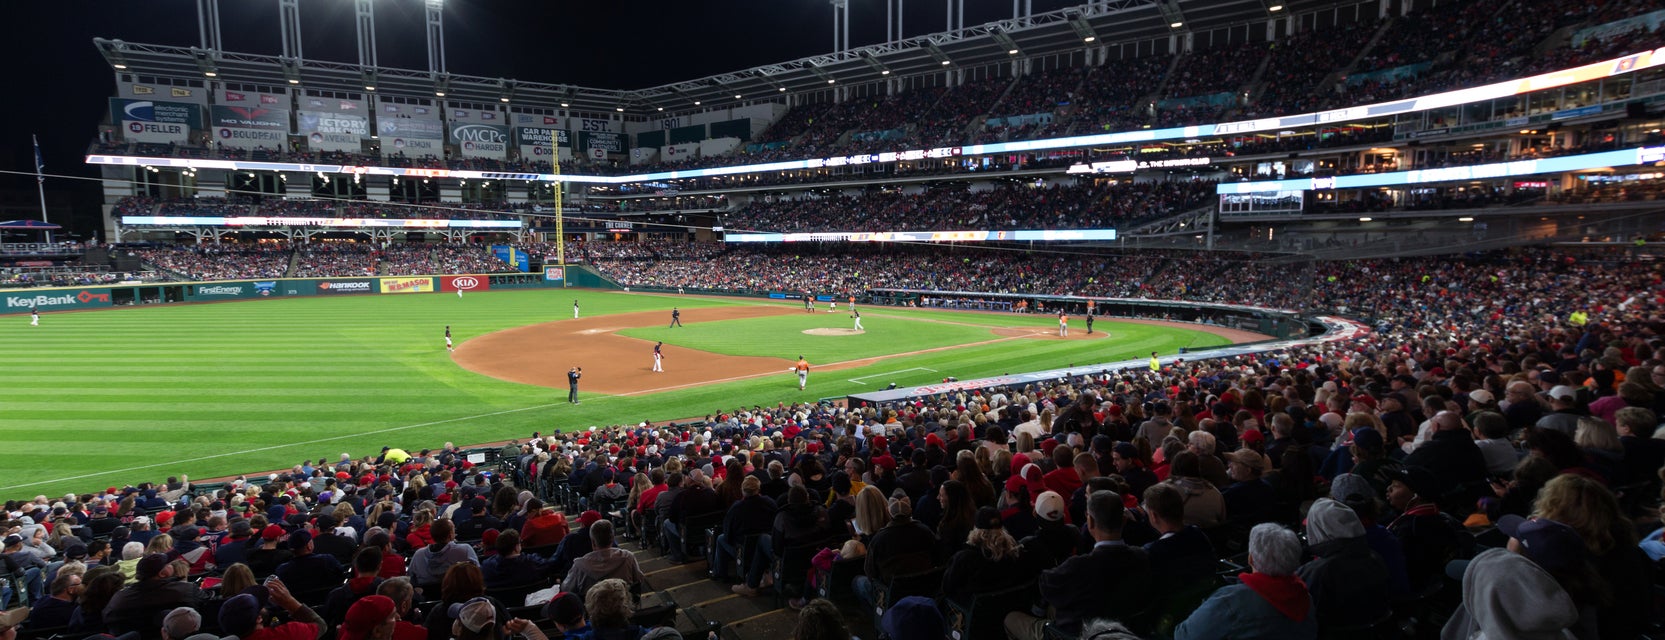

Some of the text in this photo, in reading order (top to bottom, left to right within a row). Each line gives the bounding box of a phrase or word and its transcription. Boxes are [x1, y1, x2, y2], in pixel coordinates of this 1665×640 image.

[144, 124, 182, 134] FELLER
[582, 120, 612, 132] EST.
[232, 130, 281, 140] BOUDREAU
[522, 134, 568, 142] WAREHOSE
[476, 144, 504, 152] HARDER
[199, 286, 242, 296] FirstEnergy
[7, 294, 76, 308] KeyBank
